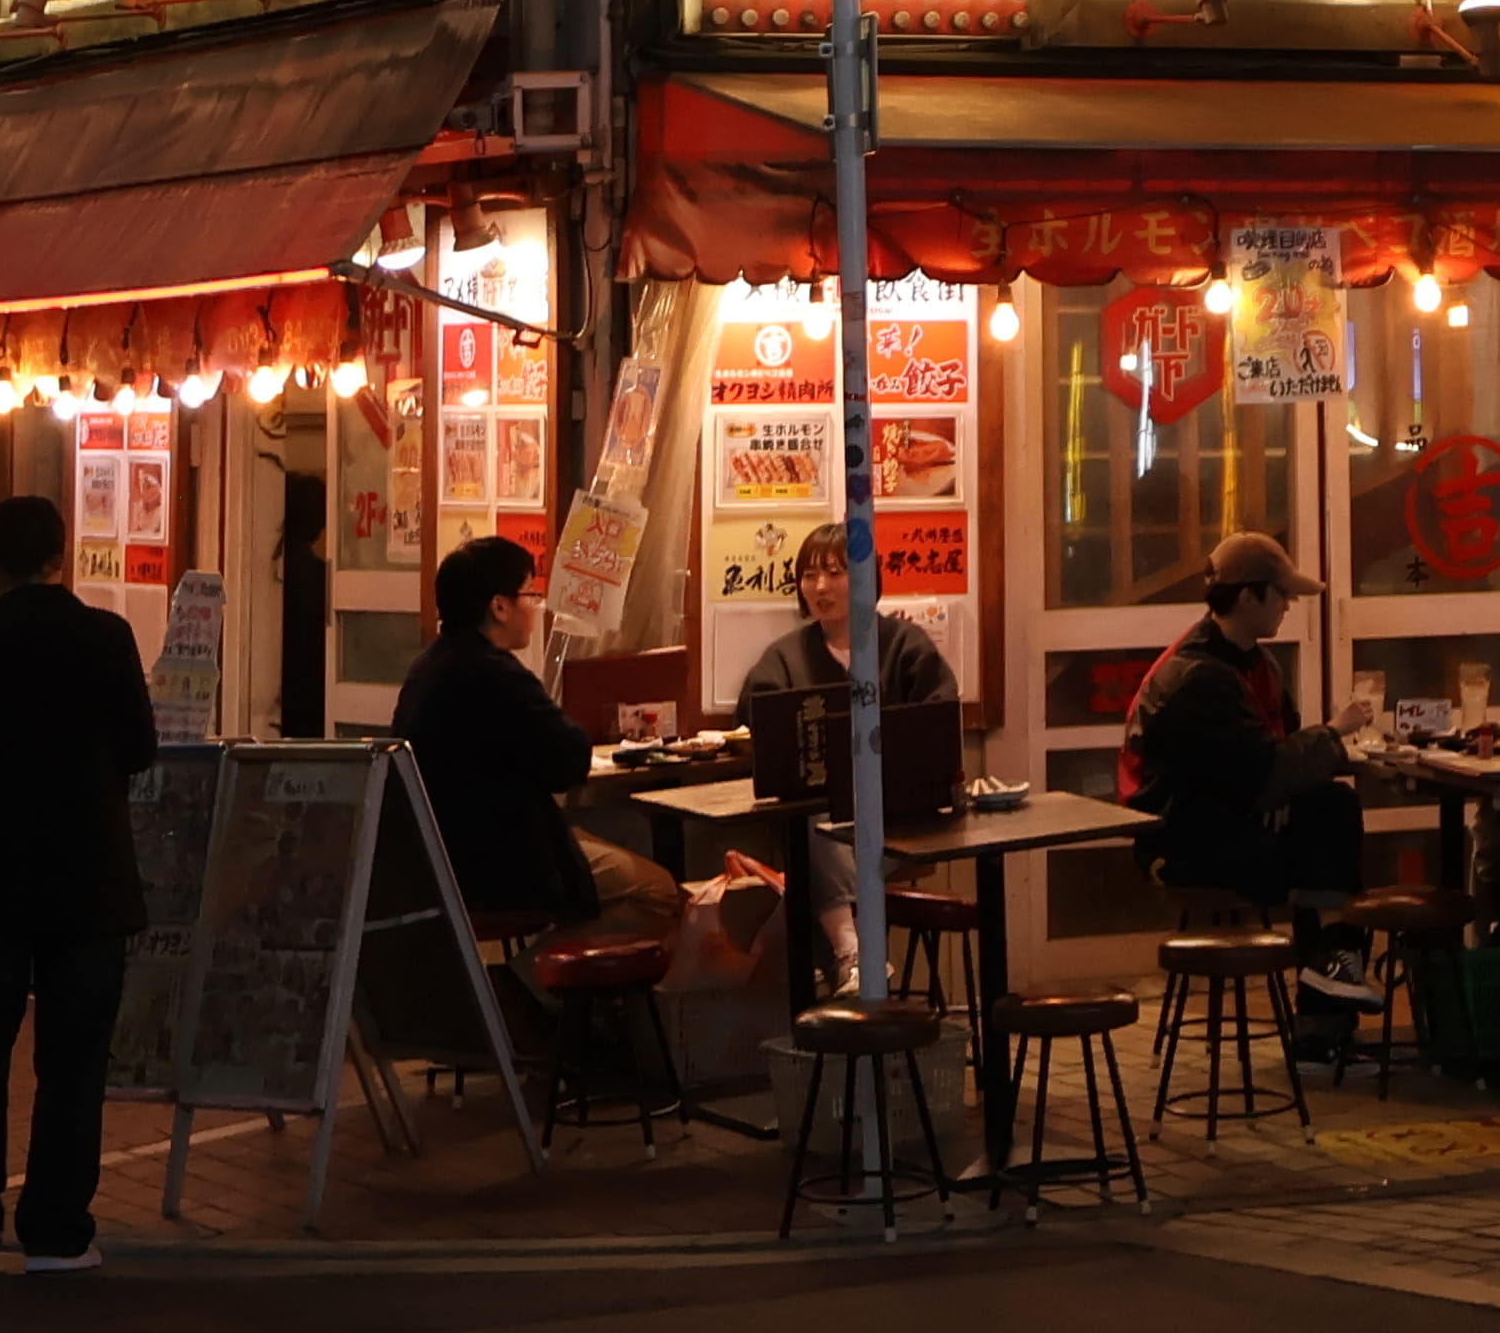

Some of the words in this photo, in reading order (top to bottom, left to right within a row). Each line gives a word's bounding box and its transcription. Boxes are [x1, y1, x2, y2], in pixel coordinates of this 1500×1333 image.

[1132, 305, 1201, 354] ガード
[711, 379, 835, 402] オクヨシ精肉所
[903, 357, 967, 400] 餃子
[1151, 353, 1191, 402] 下
[762, 423, 825, 436] 生ホルモン
[355, 492, 379, 539] 2F
[1406, 556, 1430, 587] 本
